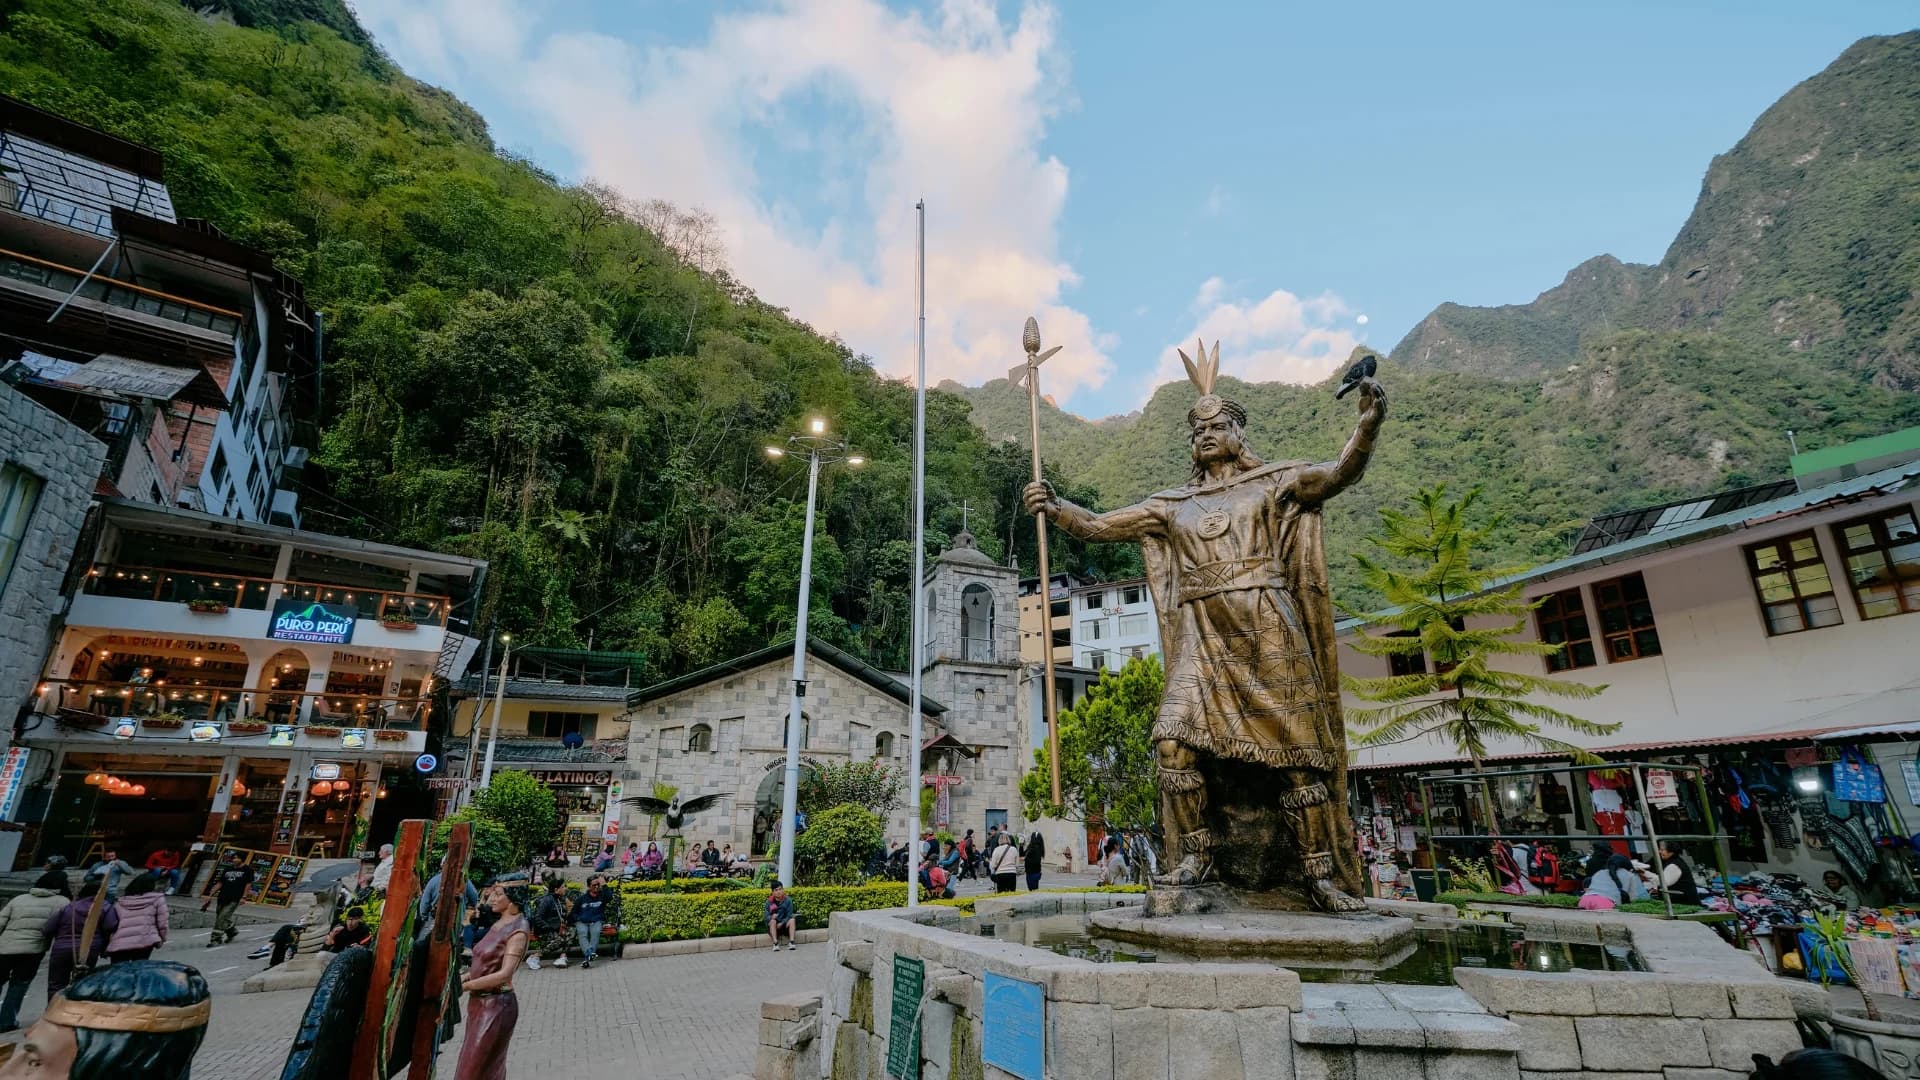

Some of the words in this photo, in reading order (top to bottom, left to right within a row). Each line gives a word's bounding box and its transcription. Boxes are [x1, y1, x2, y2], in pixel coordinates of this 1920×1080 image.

[275, 618, 314, 631] PURO
[274, 631, 344, 643] RESTAURANTE
[546, 771, 594, 784] LATINO
